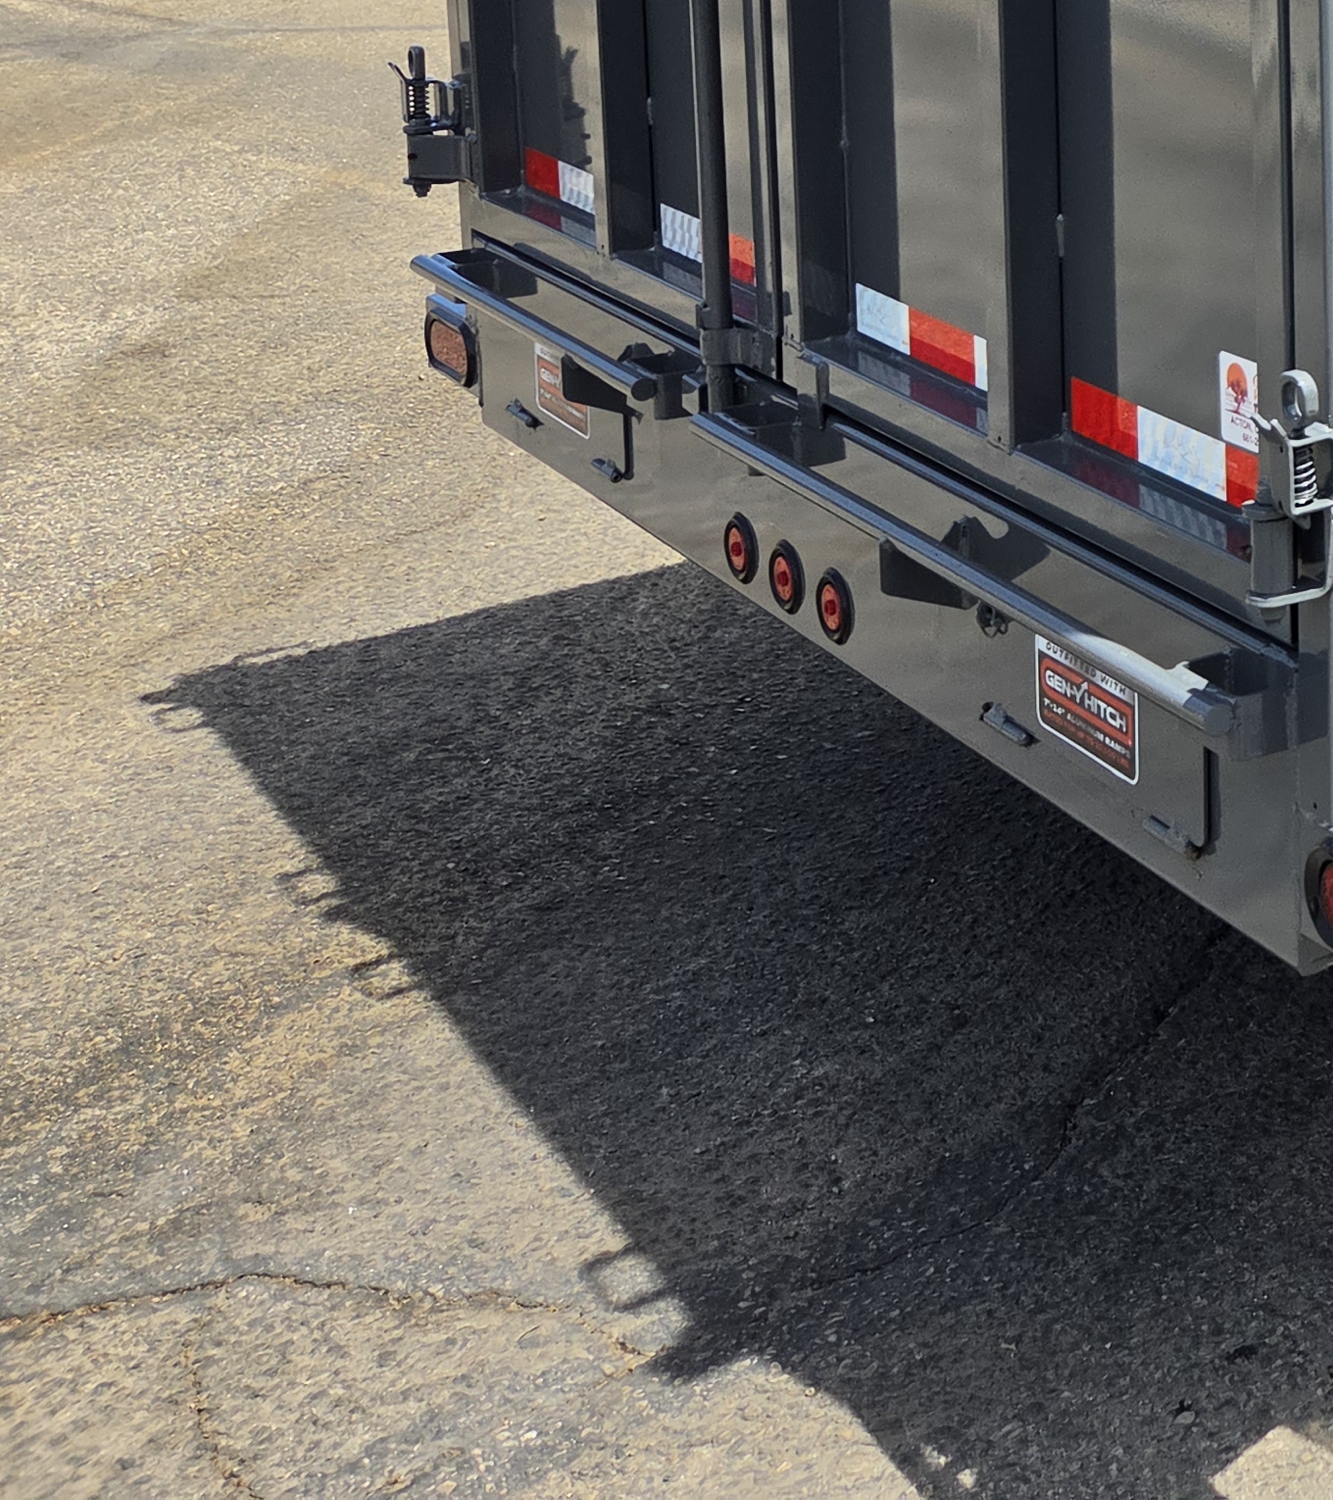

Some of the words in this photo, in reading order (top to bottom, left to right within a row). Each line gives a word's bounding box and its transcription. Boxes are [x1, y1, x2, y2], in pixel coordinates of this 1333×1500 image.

[1045, 641, 1097, 677] OUTFITTED
[1100, 673, 1127, 696] WITH
[1045, 669, 1089, 704] GEN-Y
[1084, 692, 1127, 732] HITCH
